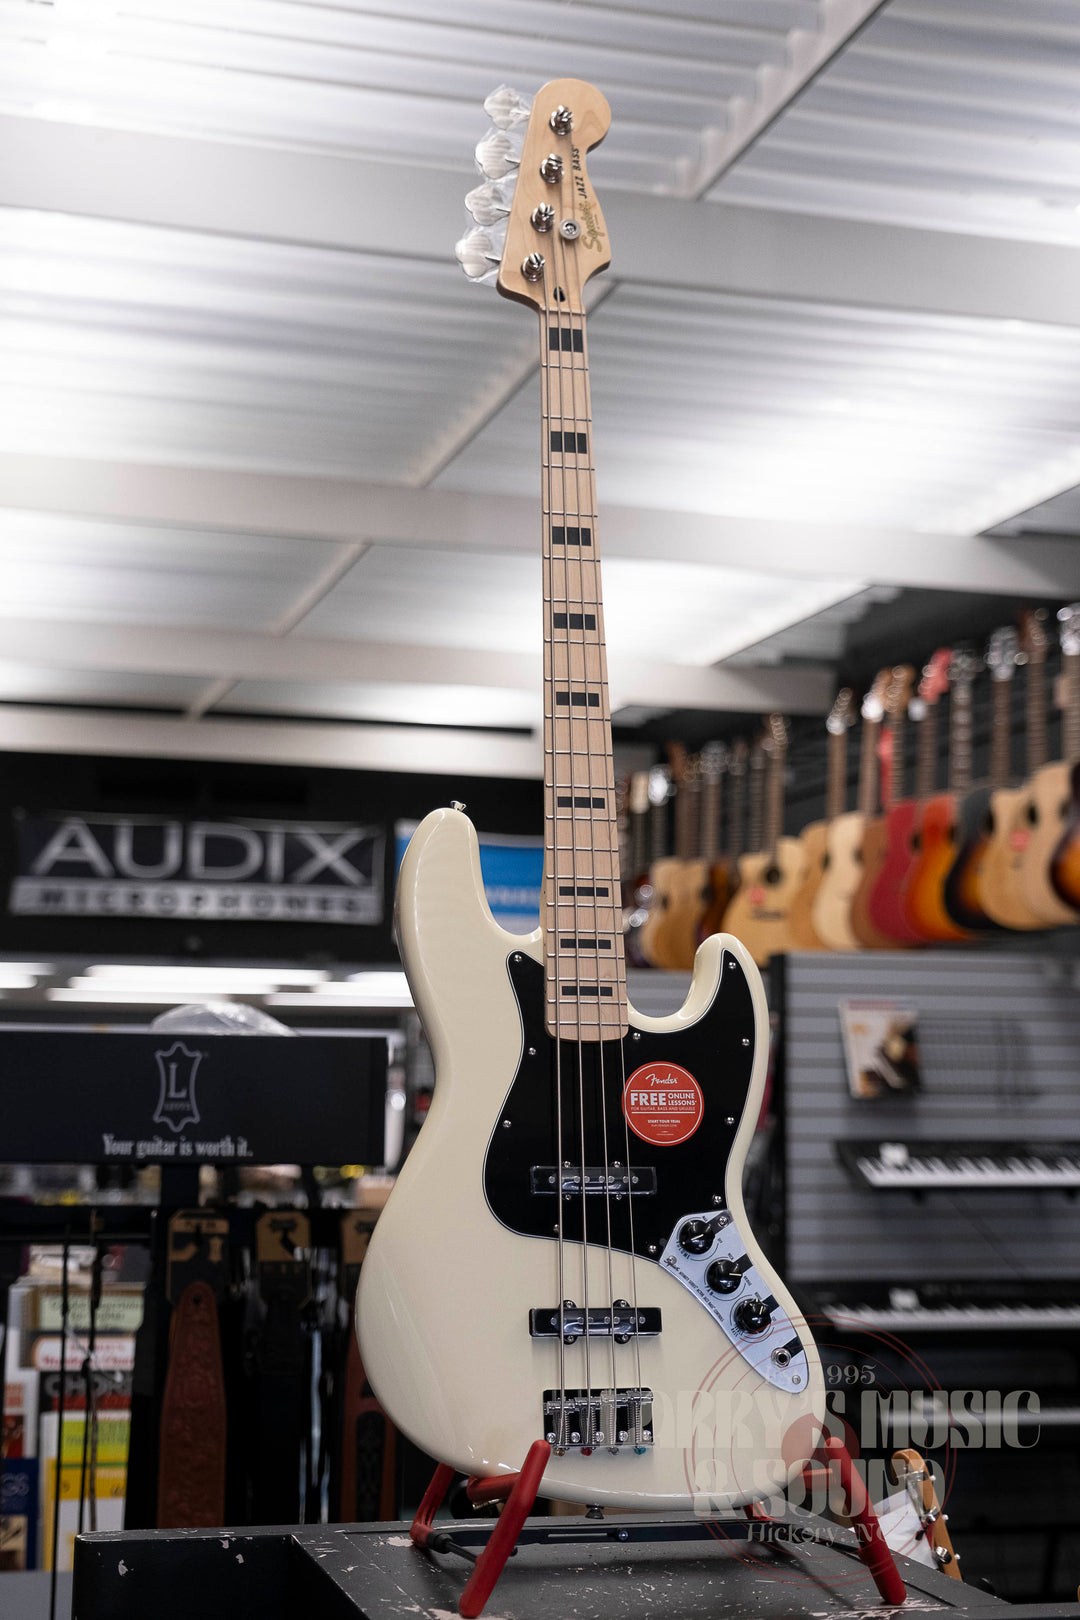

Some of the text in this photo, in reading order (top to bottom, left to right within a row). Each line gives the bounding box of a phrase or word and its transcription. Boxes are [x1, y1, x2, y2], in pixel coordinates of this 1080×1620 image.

[571, 148, 588, 199] JAZZ BASS
[29, 816, 370, 887] AUDIX
[167, 1062, 187, 1098] L
[645, 1073, 678, 1087] Fender
[630, 1092, 667, 1106] FREE
[102, 1133, 133, 1155] Your
[136, 1134, 177, 1159] guitar
[179, 1134, 192, 1156] is
[195, 1134, 235, 1156] worth
